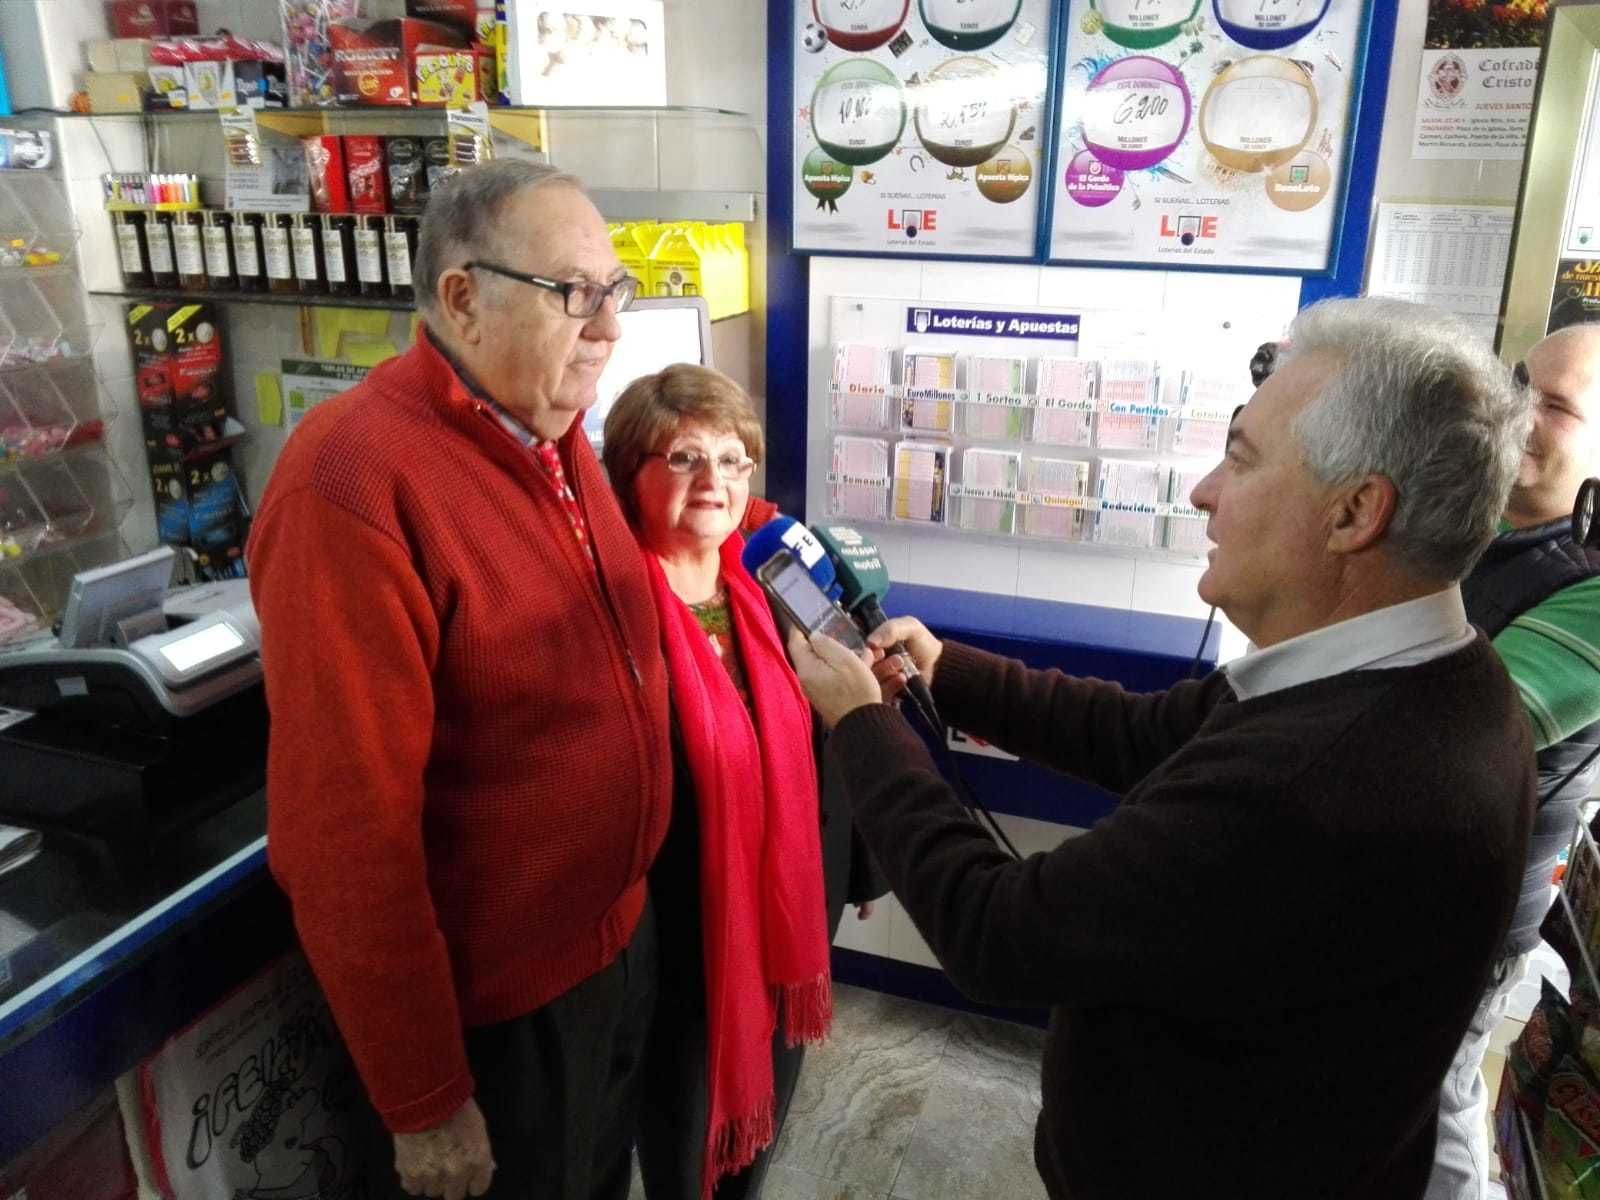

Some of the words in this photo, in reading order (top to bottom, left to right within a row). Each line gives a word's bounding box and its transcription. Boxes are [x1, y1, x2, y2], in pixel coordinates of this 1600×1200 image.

[1482, 75, 1532, 88] Cristo
[933, 314, 992, 330] Loterías
[997, 321, 1007, 333] y
[1008, 319, 1078, 335] Apuestas
[134, 329, 143, 345] 2
[176, 328, 185, 344] 2
[849, 383, 885, 394] Diario
[907, 388, 956, 401] EuroMillones
[1045, 398, 1055, 409] El
[1058, 399, 1092, 410] Gordo
[1110, 403, 1126, 413] Con
[1129, 404, 1169, 417] Partidos
[843, 475, 885, 487] Semanal
[1101, 501, 1156, 513] Reducidas
